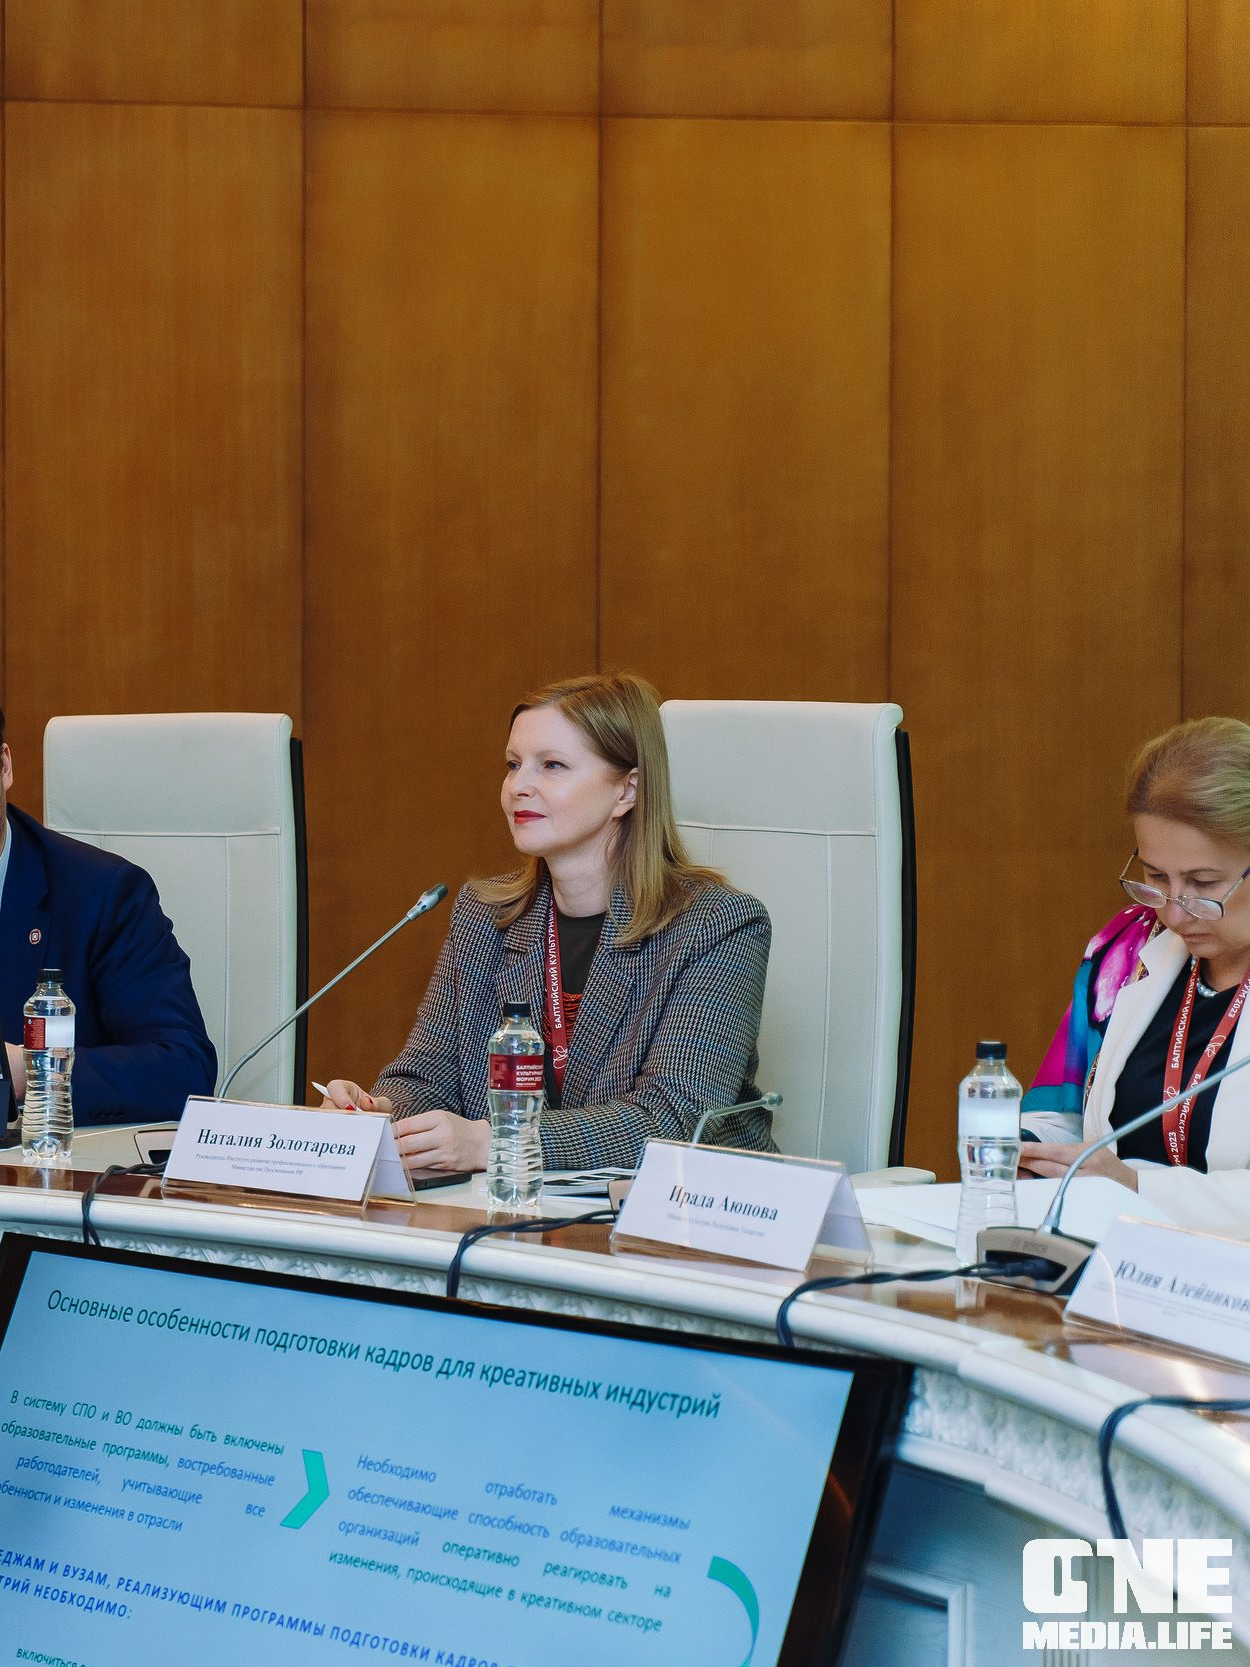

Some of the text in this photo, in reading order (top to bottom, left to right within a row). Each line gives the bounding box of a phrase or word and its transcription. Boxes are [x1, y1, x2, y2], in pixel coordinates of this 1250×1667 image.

[549, 967, 562, 1029] БАЛТИЙСКИЙ
[1228, 998, 1243, 1018] 2023
[1170, 1005, 1190, 1069] БАЛТИЙСКИЙ
[1178, 1073, 1202, 1142] БАИЙСКИЙ
[196, 1128, 356, 1158] Наталия Золотарева
[1168, 1131, 1179, 1153] 2023
[668, 1184, 780, 1221] Ирада Аюпова
[1114, 1260, 1165, 1289] Юлия
[47, 1290, 722, 1419] Основные особенности подготовки кадров для креативных индустрий
[1, 1420, 276, 1487] образовательные программы, востребованные
[10, 1390, 285, 1456] В систему СПО и ВО должны быть включены
[15, 1455, 101, 1486] работодателей,
[122, 1477, 203, 1504] учитывающие
[245, 1503, 266, 1517] все
[53, 1495, 62, 1505] и
[63, 1498, 125, 1521] изменения
[127, 1511, 134, 1521] в
[136, 1513, 183, 1532] отрасли
[356, 1455, 691, 1531] Необходимо отработать механизмы
[348, 1486, 683, 1565] обеспечивающие способность образовательных
[338, 1519, 672, 1599] организаций оперативно реагировать на
[34, 1583, 133, 1620] НЕОБХОДИМО:
[49, 1562, 59, 1575] И
[62, 1564, 111, 1589] ВУЗАМ,
[116, 1577, 228, 1614] РЕАЛИЗУЮЩИМ
[231, 1603, 326, 1637] ПРОГРАММЫ
[330, 1626, 431, 1661] ПОДГОТОВКИ
[329, 1550, 663, 1634] изменения, происходящие в креативном секторе
